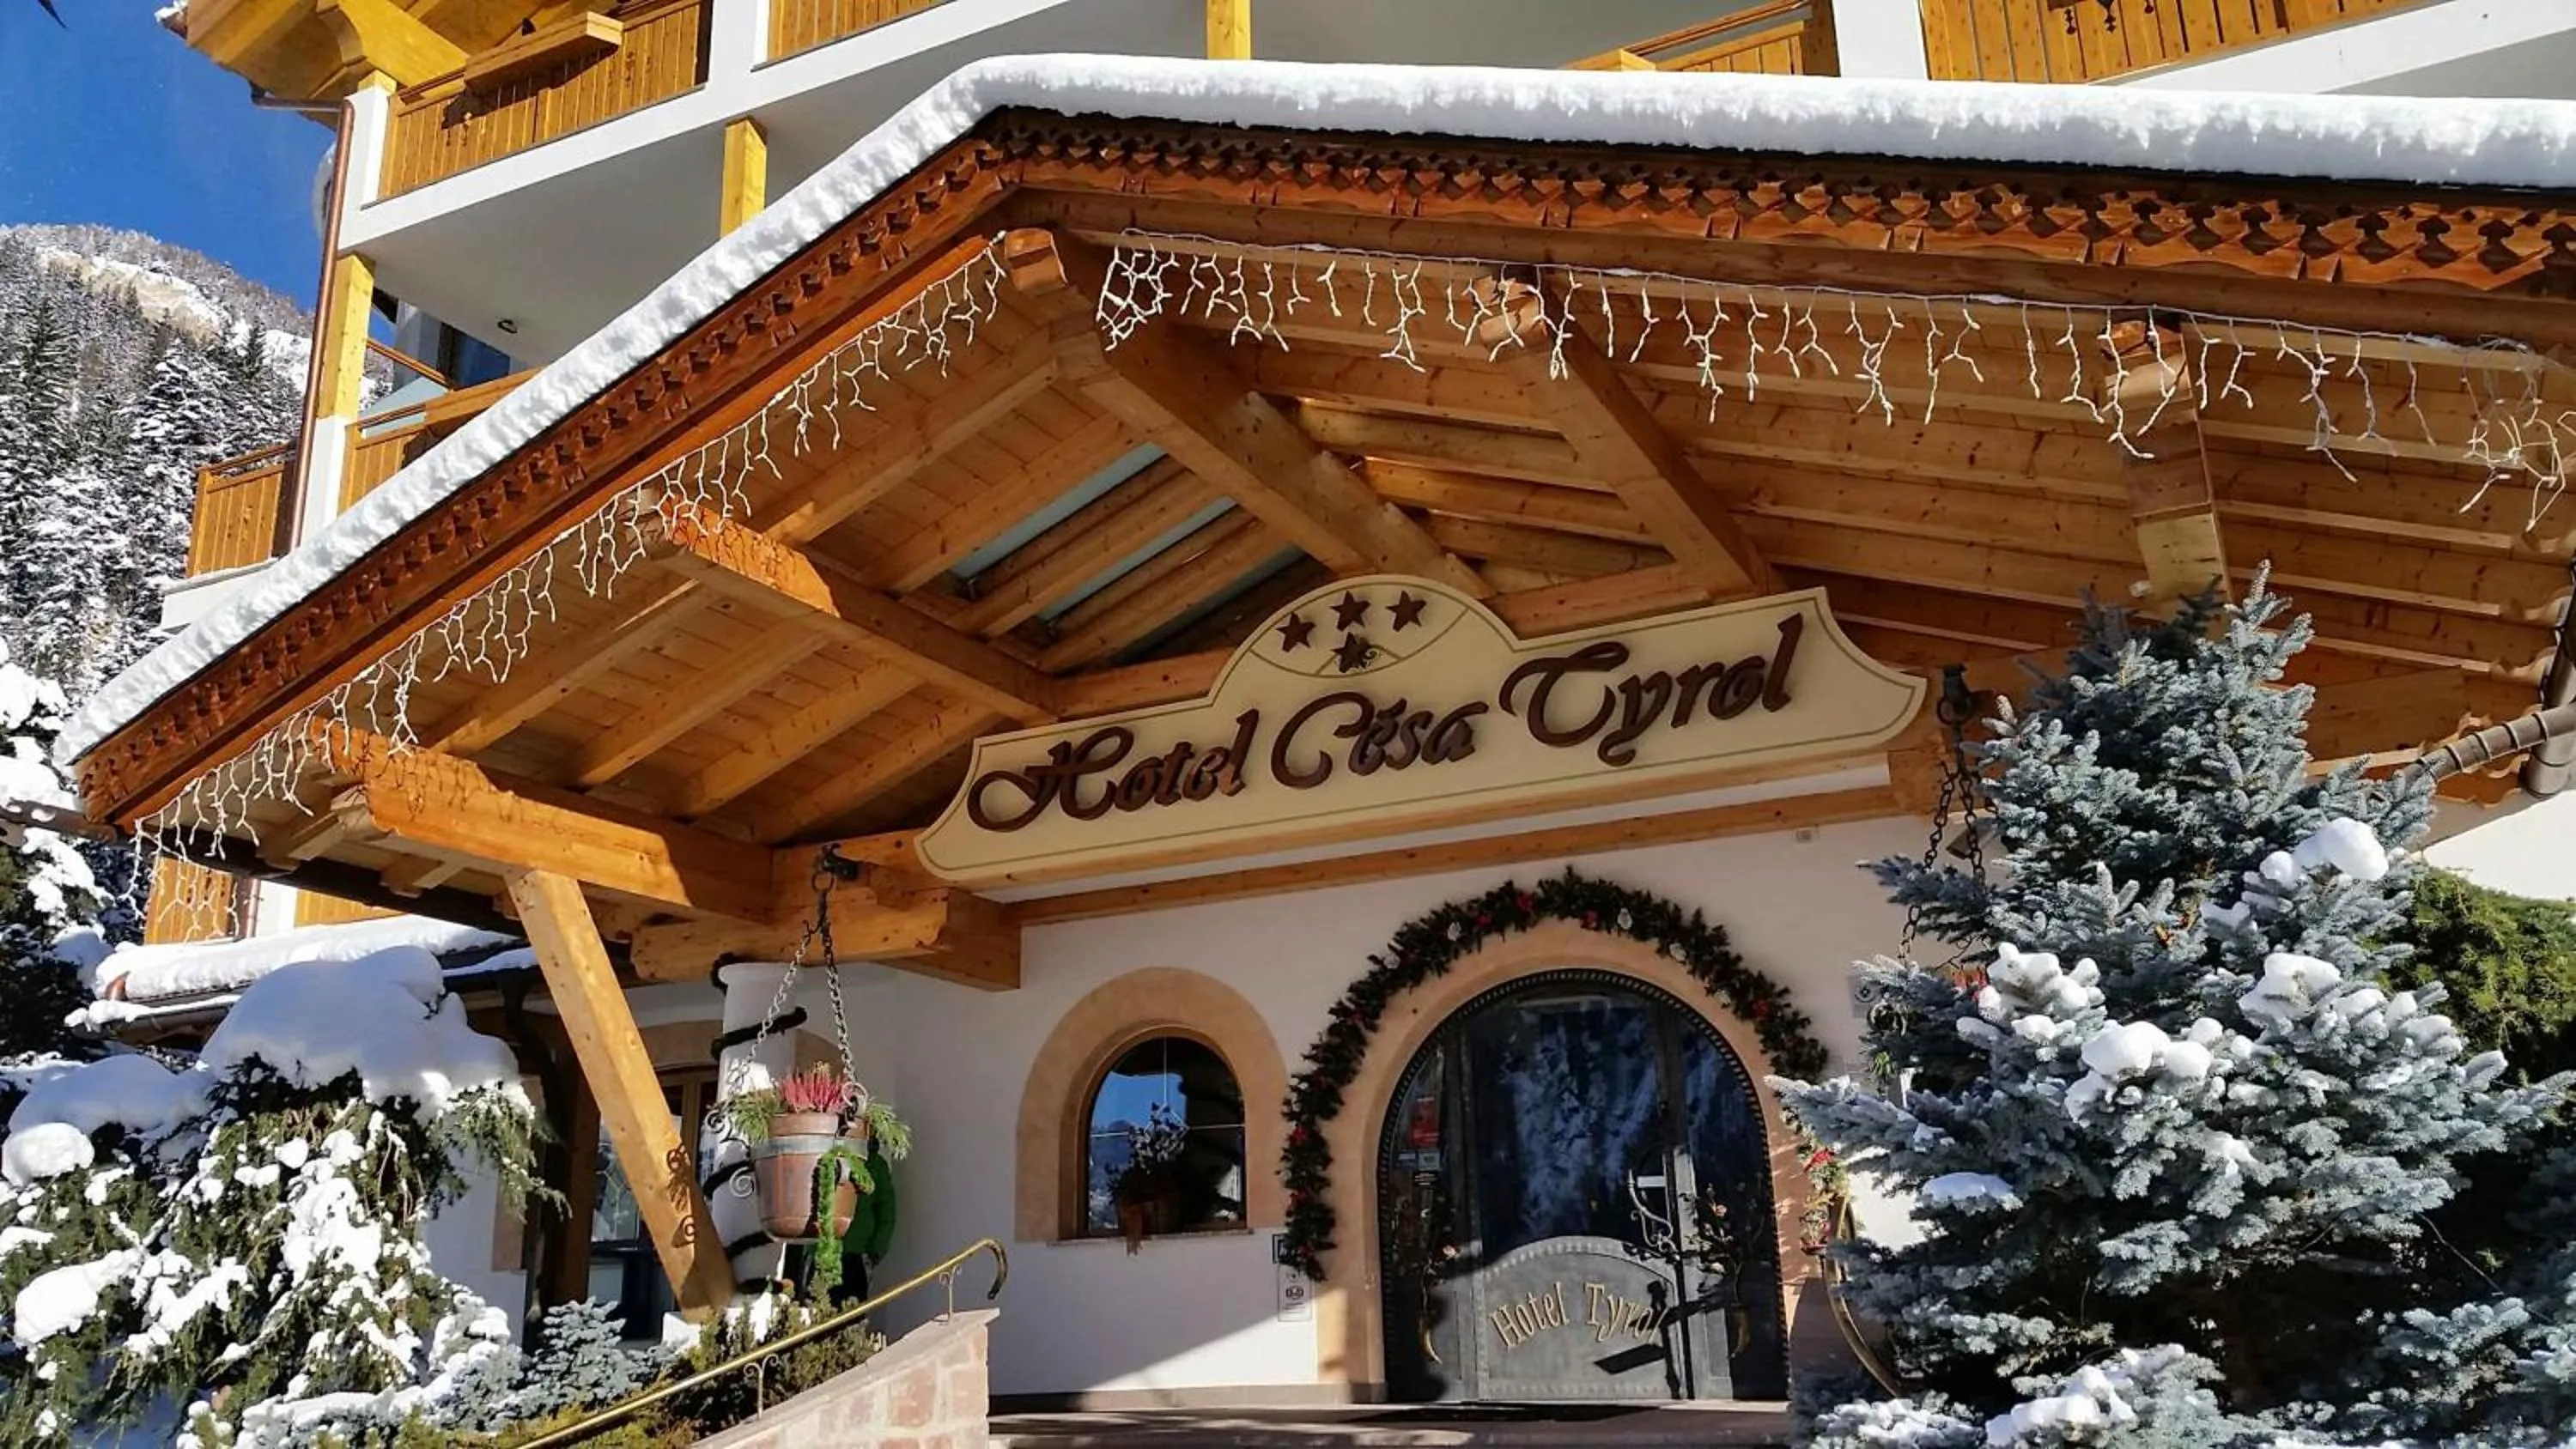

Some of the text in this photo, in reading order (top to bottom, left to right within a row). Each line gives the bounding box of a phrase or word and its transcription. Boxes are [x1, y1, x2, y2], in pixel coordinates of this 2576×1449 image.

[969, 709, 1260, 833] Hotel
[1499, 612, 1804, 767] Tyrol
[1489, 1281, 1668, 1349] Hotel Tyrol
